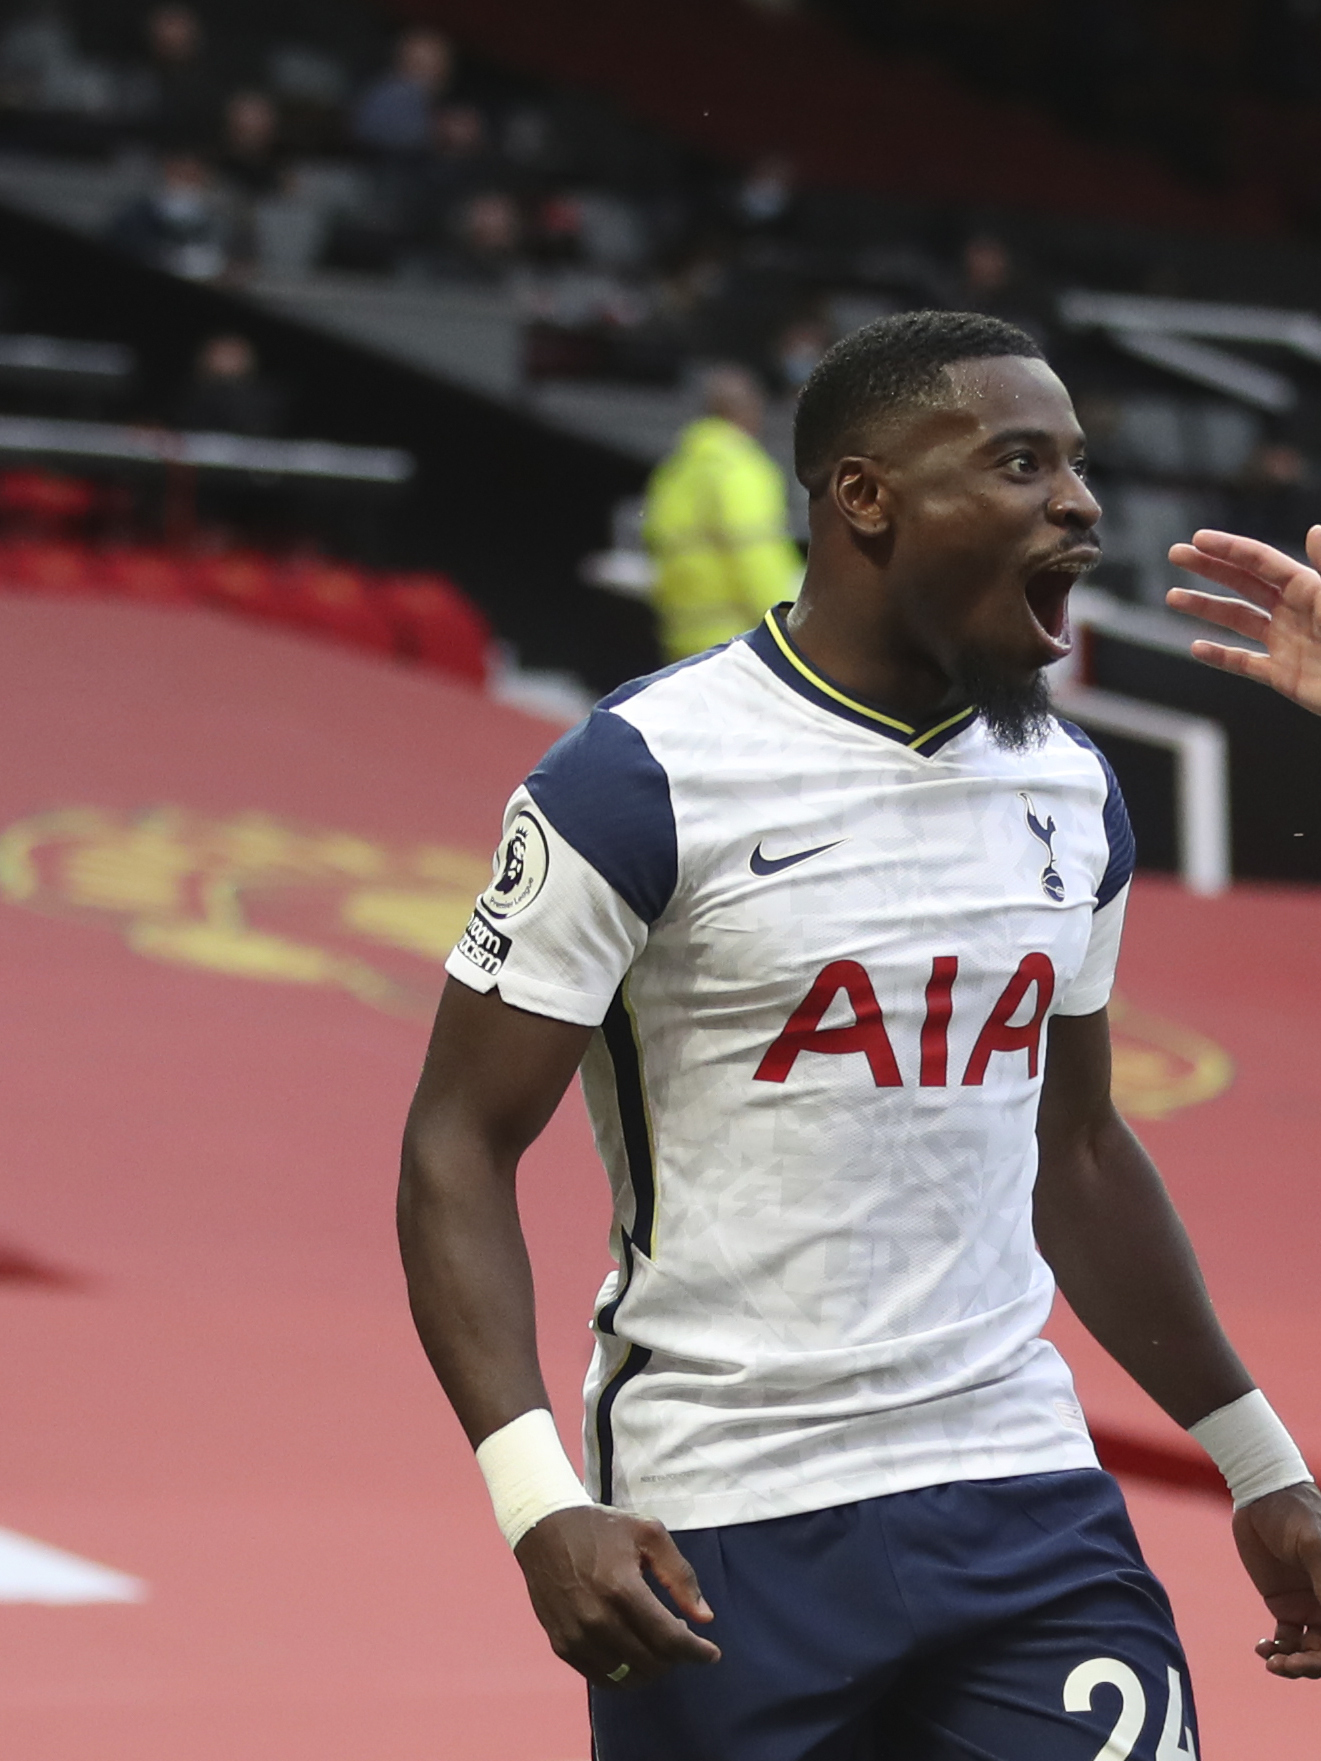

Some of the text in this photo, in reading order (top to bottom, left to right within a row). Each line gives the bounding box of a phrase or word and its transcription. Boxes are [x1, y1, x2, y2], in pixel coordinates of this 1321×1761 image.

[490, 876, 534, 908] Premier League
[752, 952, 1055, 1087] AIA
[1063, 1657, 1197, 1761] 24
